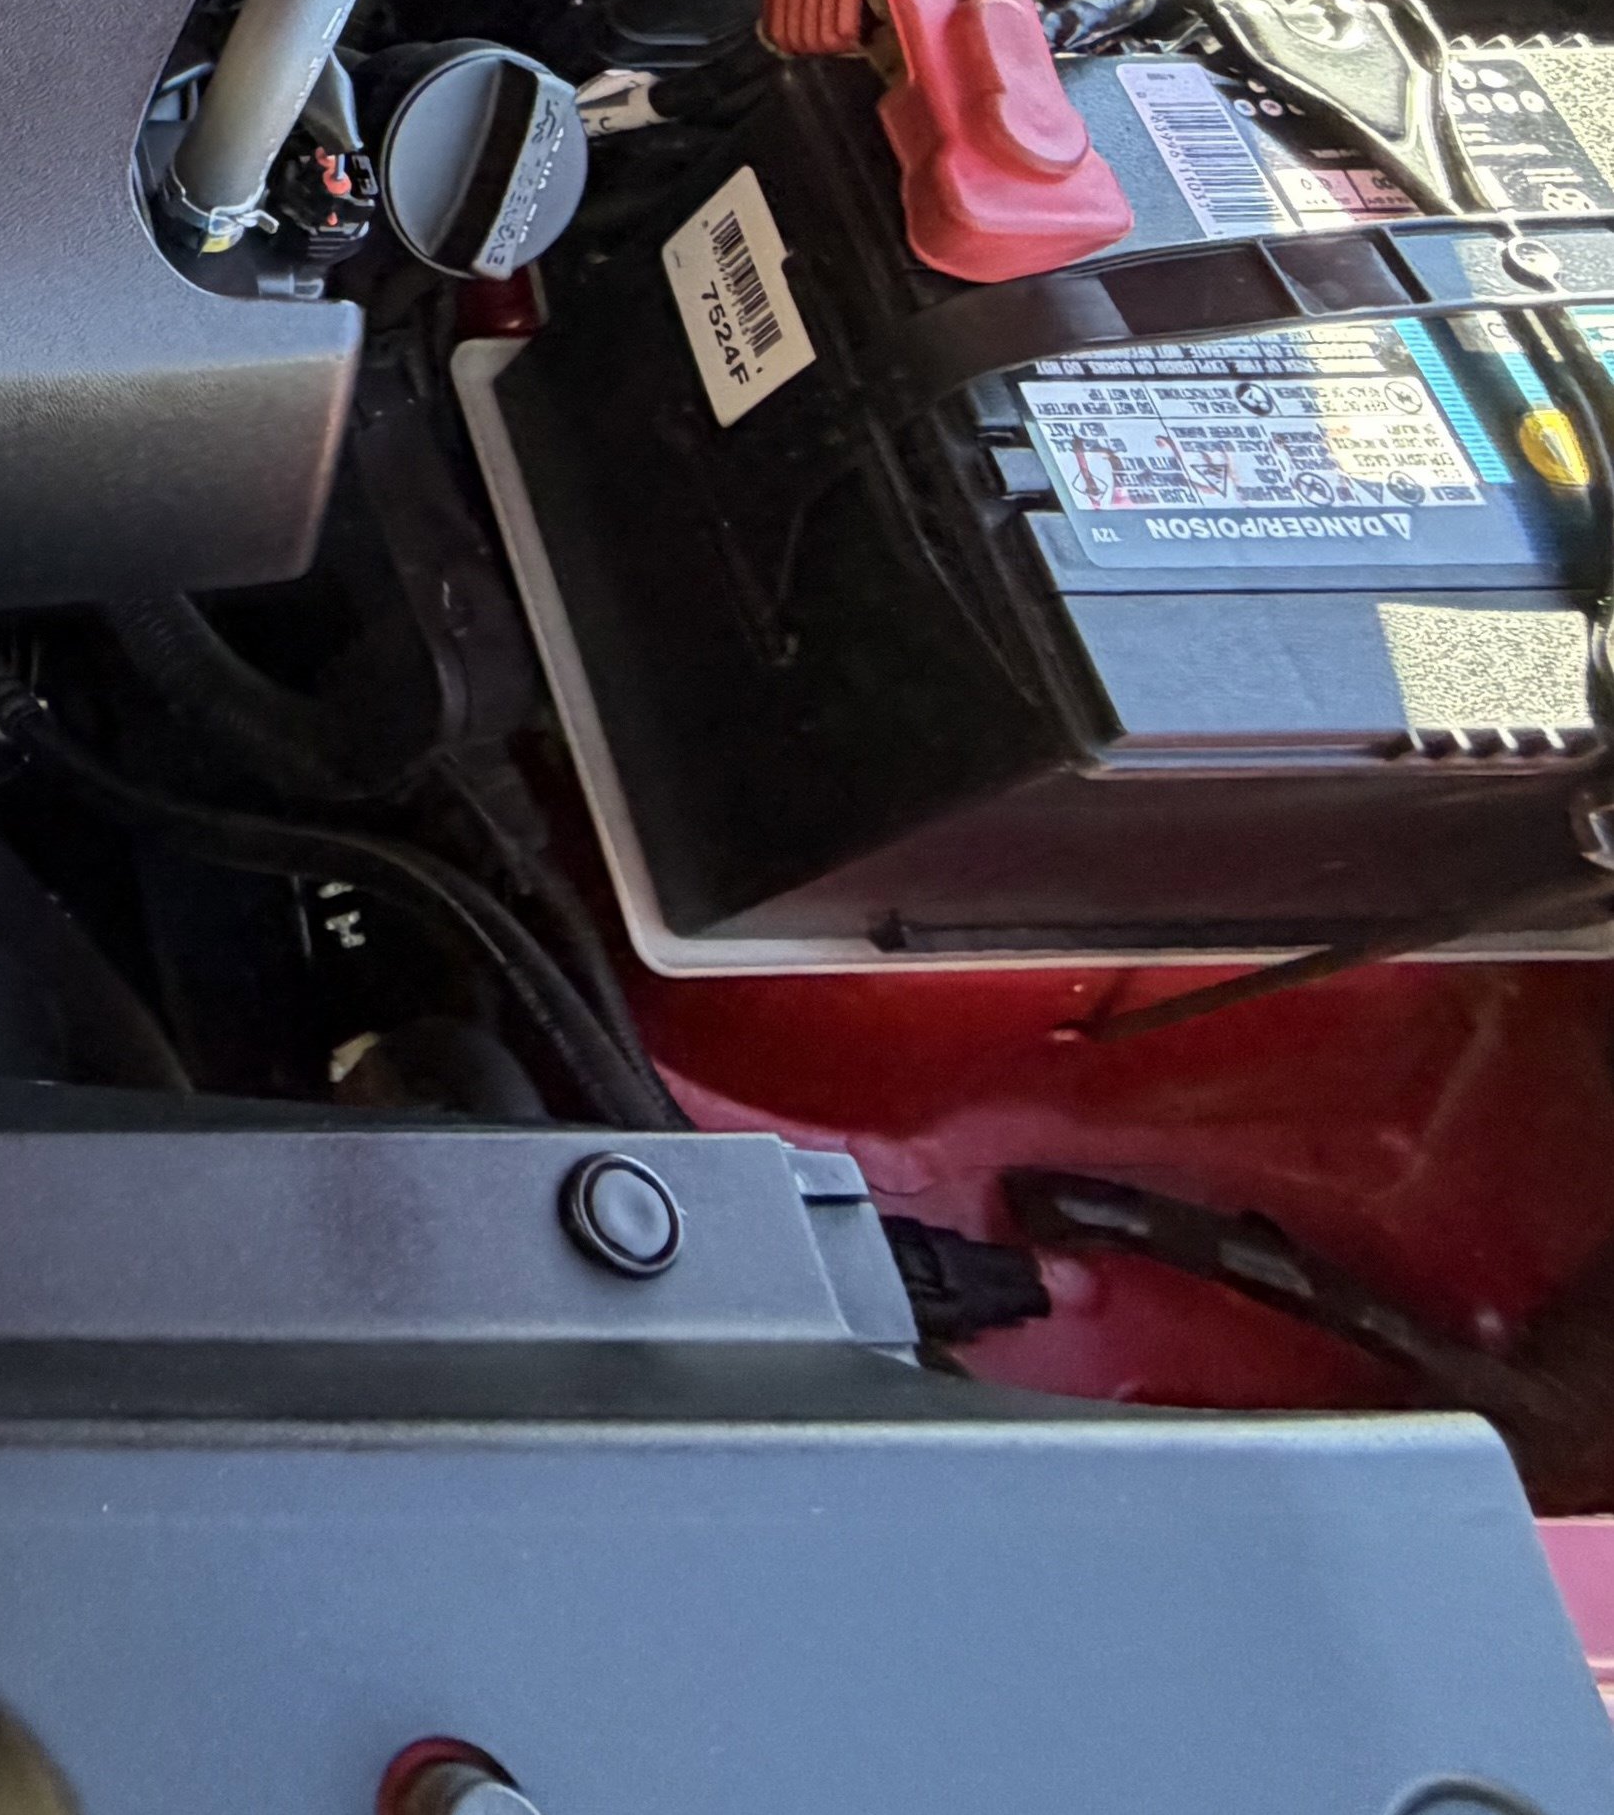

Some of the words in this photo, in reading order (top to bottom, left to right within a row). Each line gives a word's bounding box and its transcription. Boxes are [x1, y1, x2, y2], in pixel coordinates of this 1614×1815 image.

[701, 280, 750, 385] 7524F
[1090, 526, 1124, 543] 12V
[1145, 514, 1392, 540] DANGER/POISON
